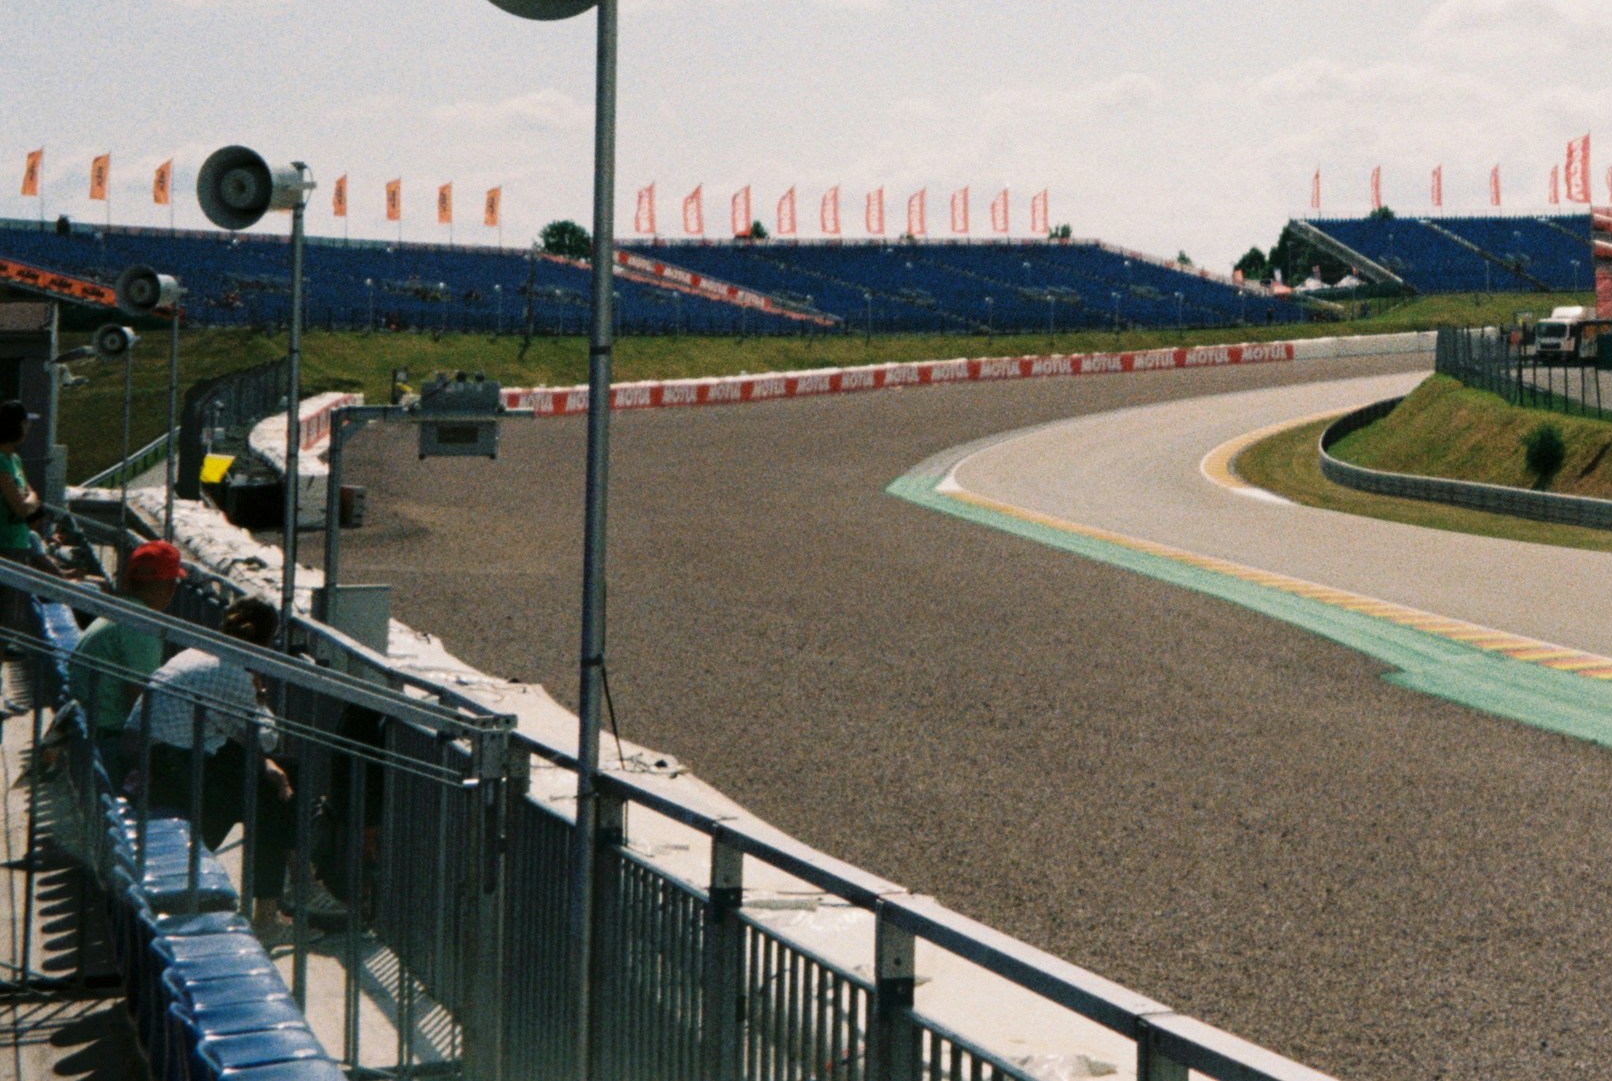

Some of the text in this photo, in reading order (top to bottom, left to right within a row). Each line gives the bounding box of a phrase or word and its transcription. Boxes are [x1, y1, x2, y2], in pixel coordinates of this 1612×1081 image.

[1032, 356, 1071, 375] MOTUL
[1082, 354, 1121, 373] MOTUL
[1133, 350, 1176, 369] MOTUL
[1184, 346, 1230, 366] MOTUL
[1241, 343, 1286, 363] MOTUL
